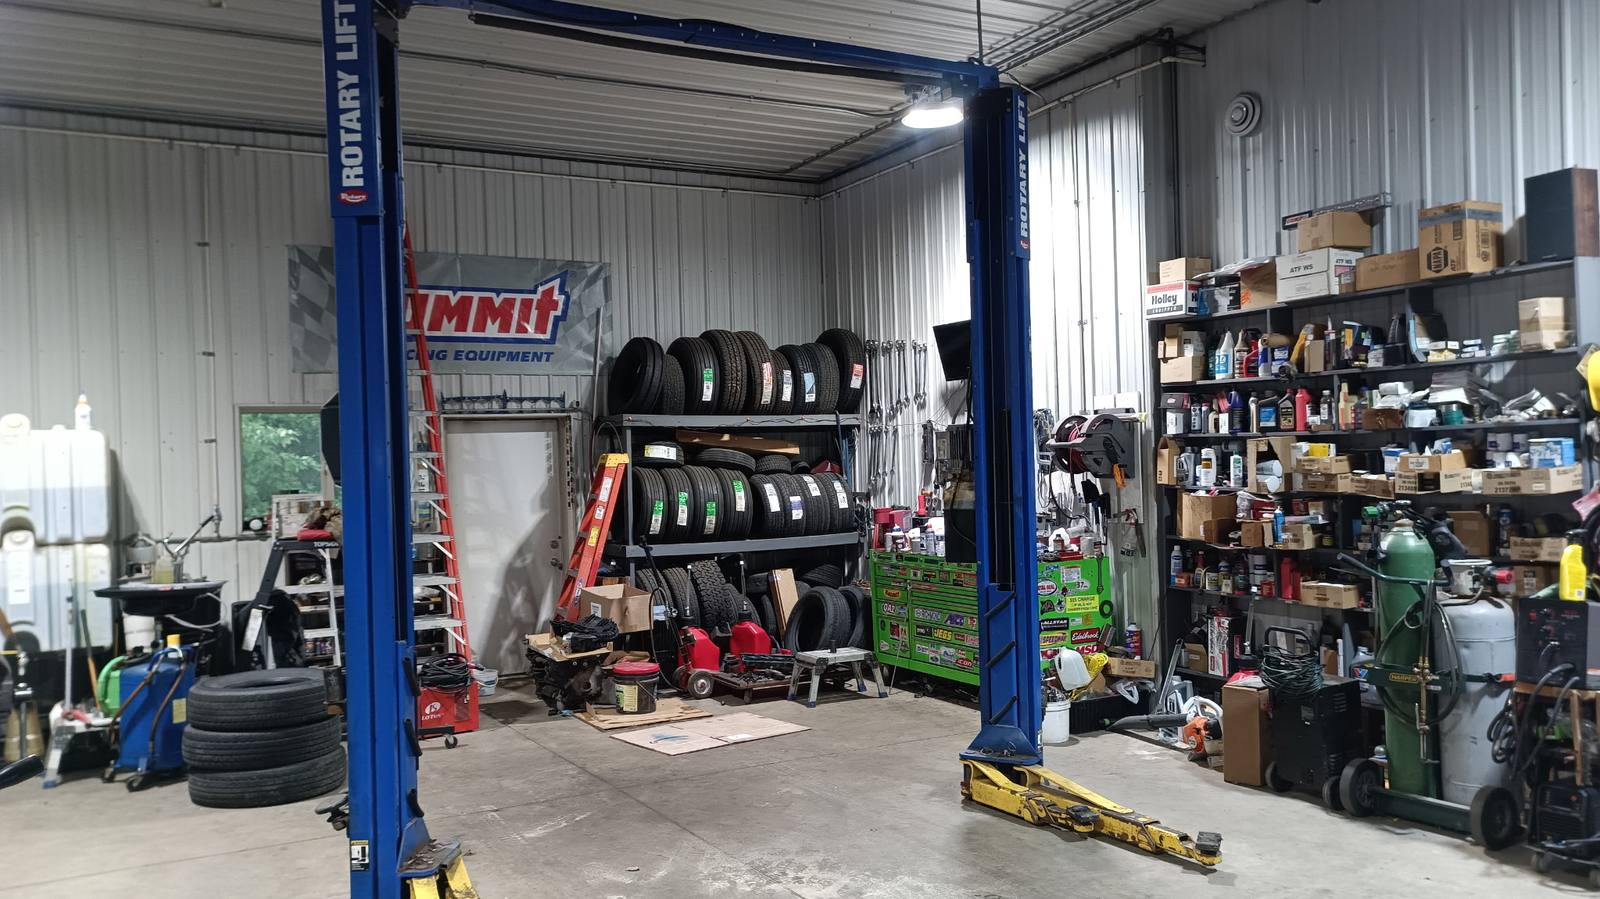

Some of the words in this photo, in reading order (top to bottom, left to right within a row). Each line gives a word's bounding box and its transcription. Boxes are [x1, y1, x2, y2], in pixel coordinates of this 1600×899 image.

[335, 0, 359, 61] LIFT
[1017, 96, 1026, 142] LIFT
[337, 70, 365, 187] ROTARY
[1018, 149, 1029, 238] ROTARY
[1431, 250, 1444, 270] NAPA
[1289, 265, 1302, 273] ATF
[1151, 293, 1177, 305] Holley
[453, 350, 555, 363] EQUIPMENT
[935, 628, 953, 640] JEGS
[1072, 630, 1099, 641] Edelbrock
[1077, 645, 1098, 655] MSD
